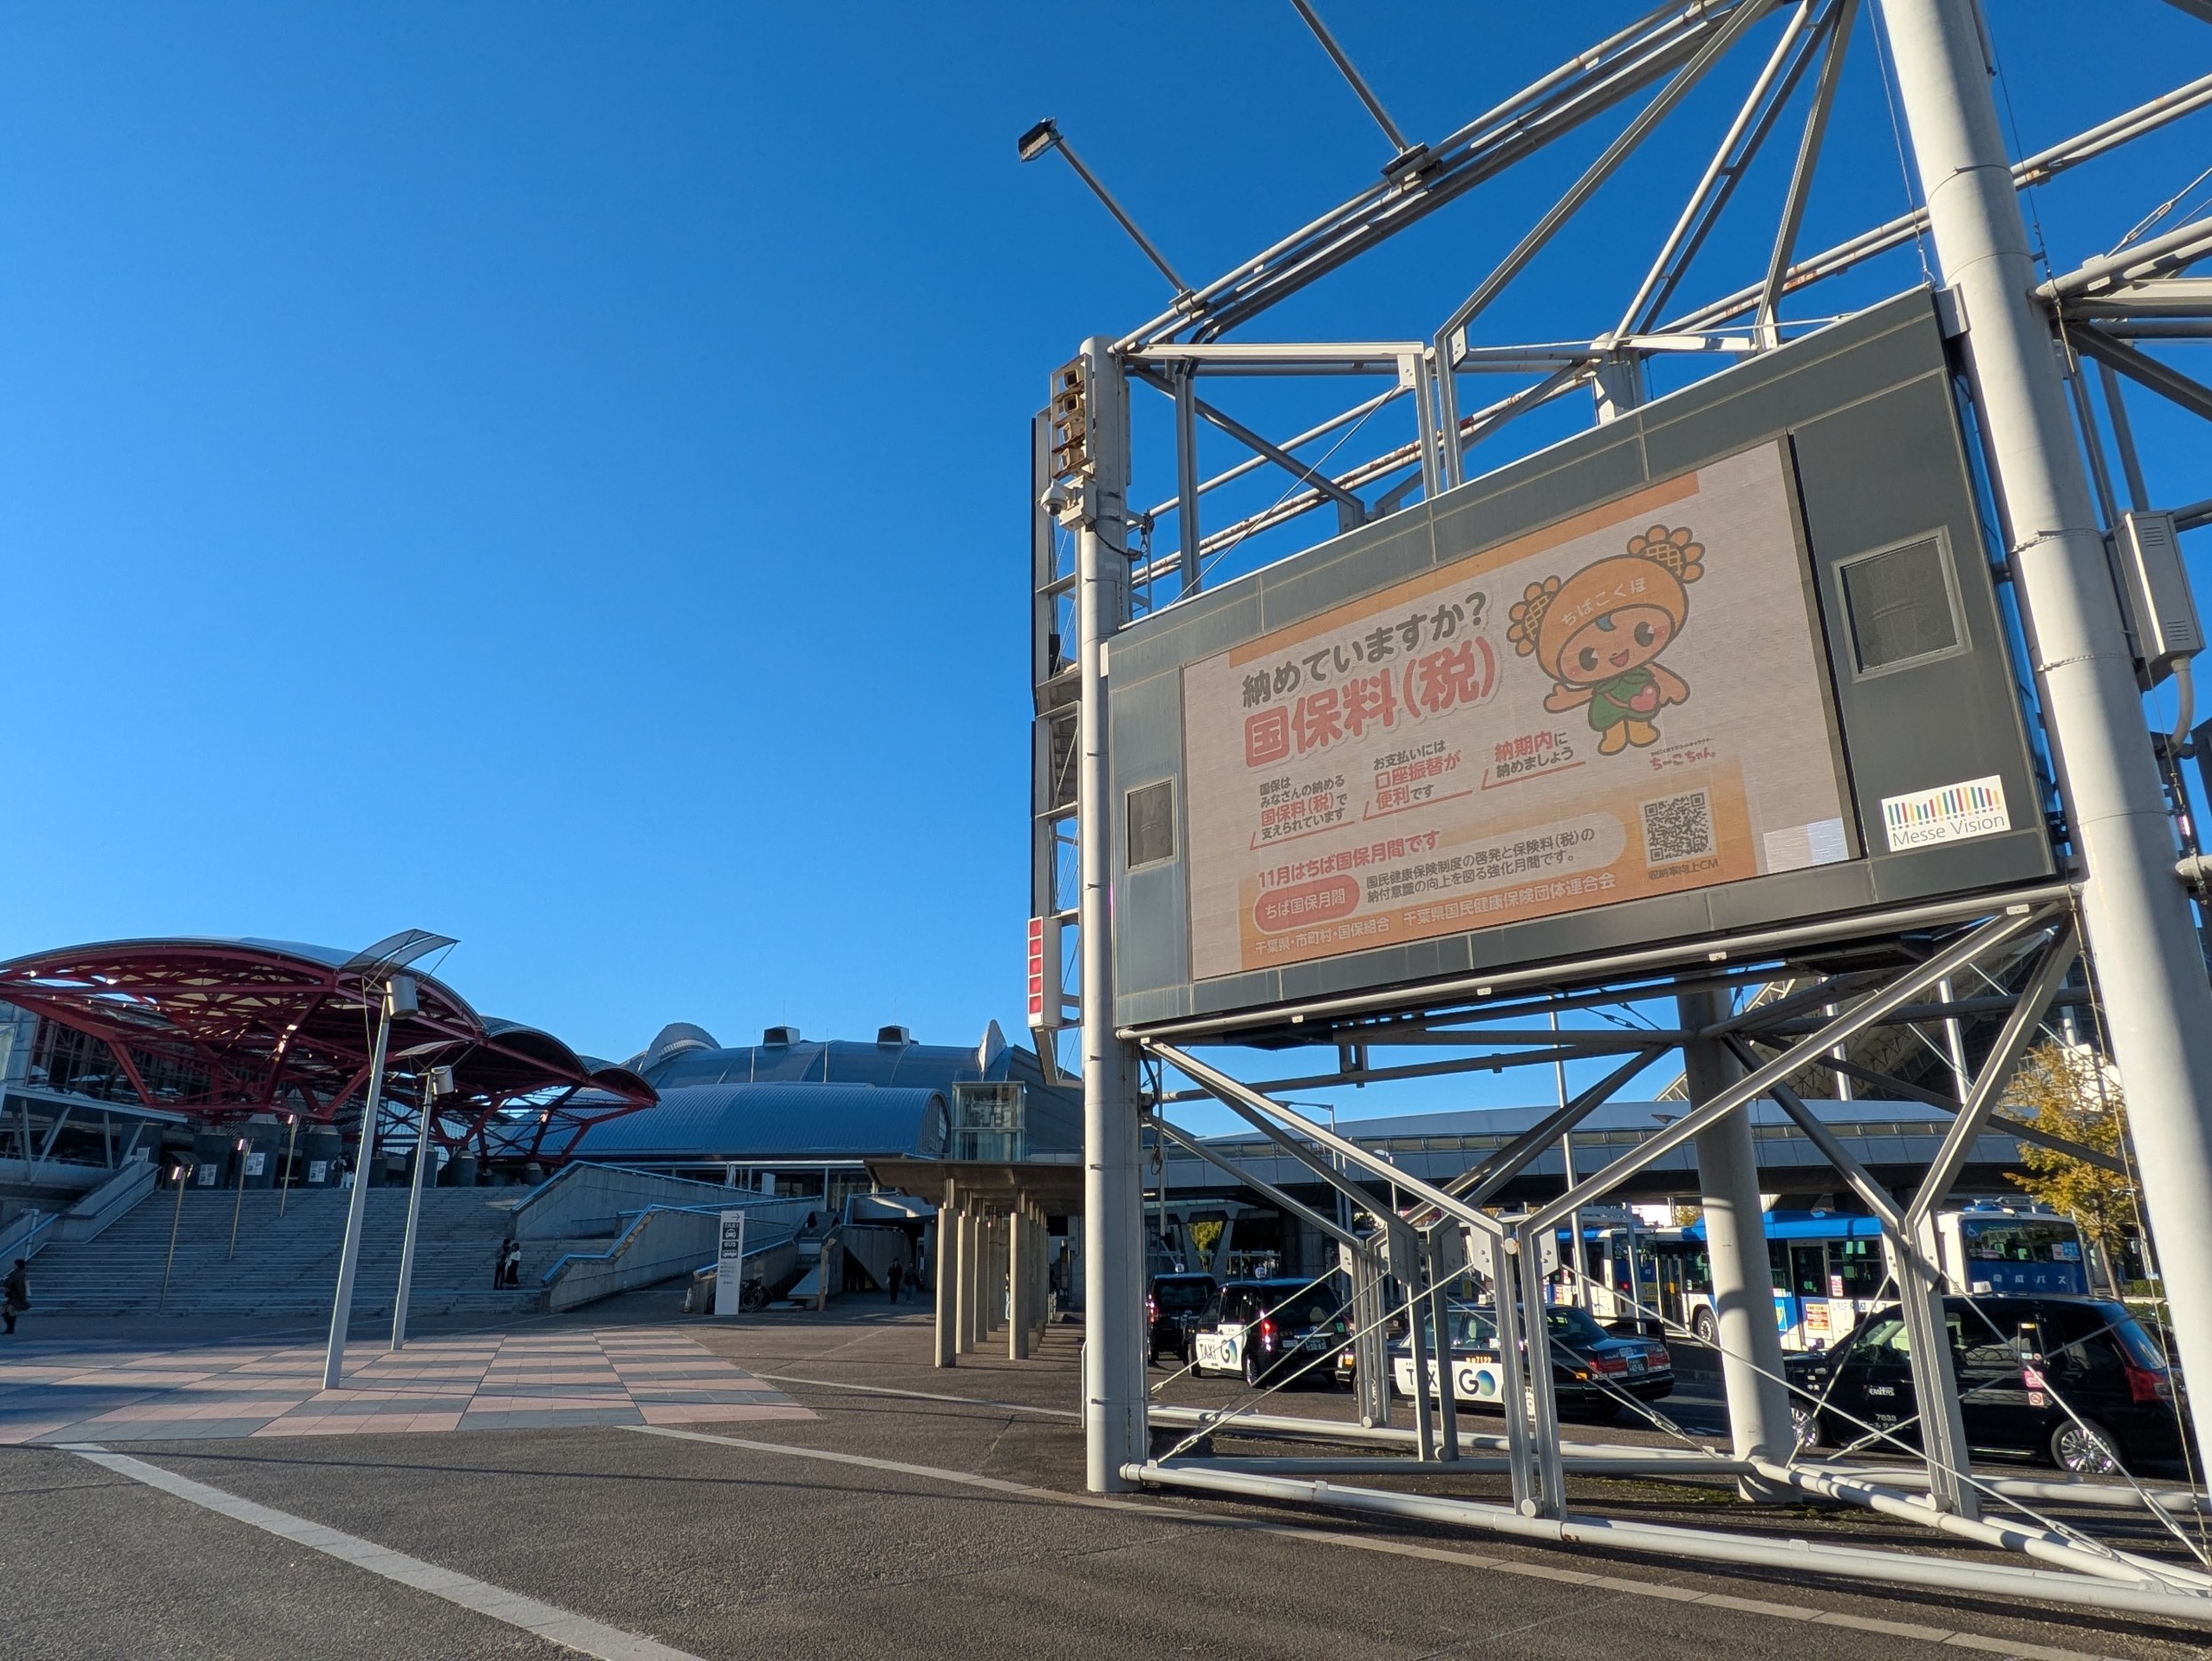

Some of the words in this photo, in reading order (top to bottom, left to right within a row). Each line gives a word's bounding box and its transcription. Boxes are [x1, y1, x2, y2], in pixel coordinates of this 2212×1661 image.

[1562, 577, 1647, 626] ちばこくほ
[1243, 592, 1486, 708] 納めていますか?
[1244, 637, 1495, 767] 国保料(税)
[1373, 740, 1446, 771] お支払いには
[1495, 731, 1568, 763] 納期内に
[1496, 746, 1574, 779] 納めましょう
[1260, 776, 1291, 795] 国保は
[1375, 749, 1462, 790] 口座振替が
[1260, 774, 1346, 808] みなさんの納める
[1376, 784, 1434, 811] 便利です
[1261, 792, 1347, 827] 国保料(税)で
[1261, 808, 1345, 840] 支えられています
[1892, 827, 1946, 847] Messe
[1950, 816, 2005, 835] Vision
[1259, 830, 1440, 888] 11月はちば国保月間です
[1367, 850, 1575, 903] 納付意識の向上を図る強化月間です。
[1255, 916, 1390, 955] 千葉県・市町村・国保組合
[1403, 872, 1616, 927] 千葉県国民健康保険団体連合会
[1265, 888, 1345, 919] ちば国保月間
